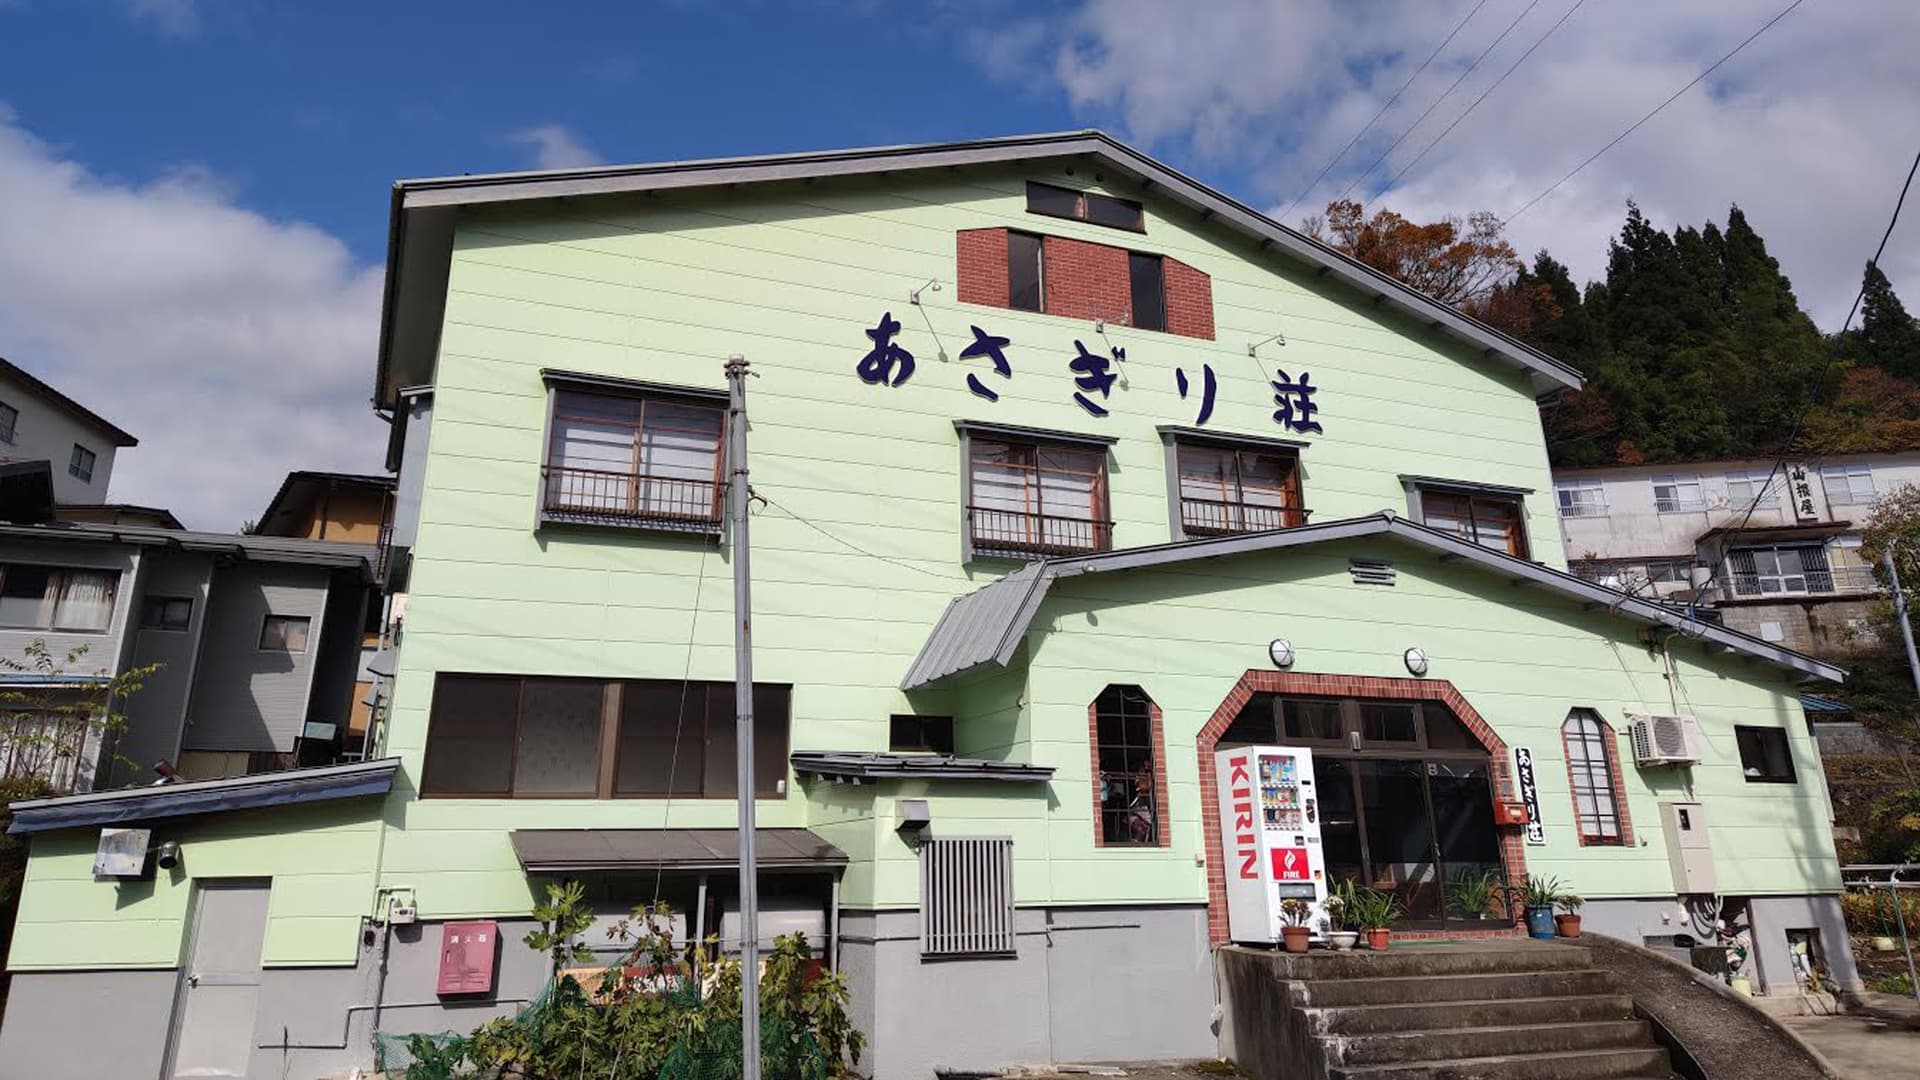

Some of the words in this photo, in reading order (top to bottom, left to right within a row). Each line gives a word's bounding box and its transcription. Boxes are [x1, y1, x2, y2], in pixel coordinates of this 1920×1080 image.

[856, 311, 1323, 435] あさぎり荘
[1229, 756, 1259, 880] KIRIN
[1518, 748, 1543, 841] あさぎり荘
